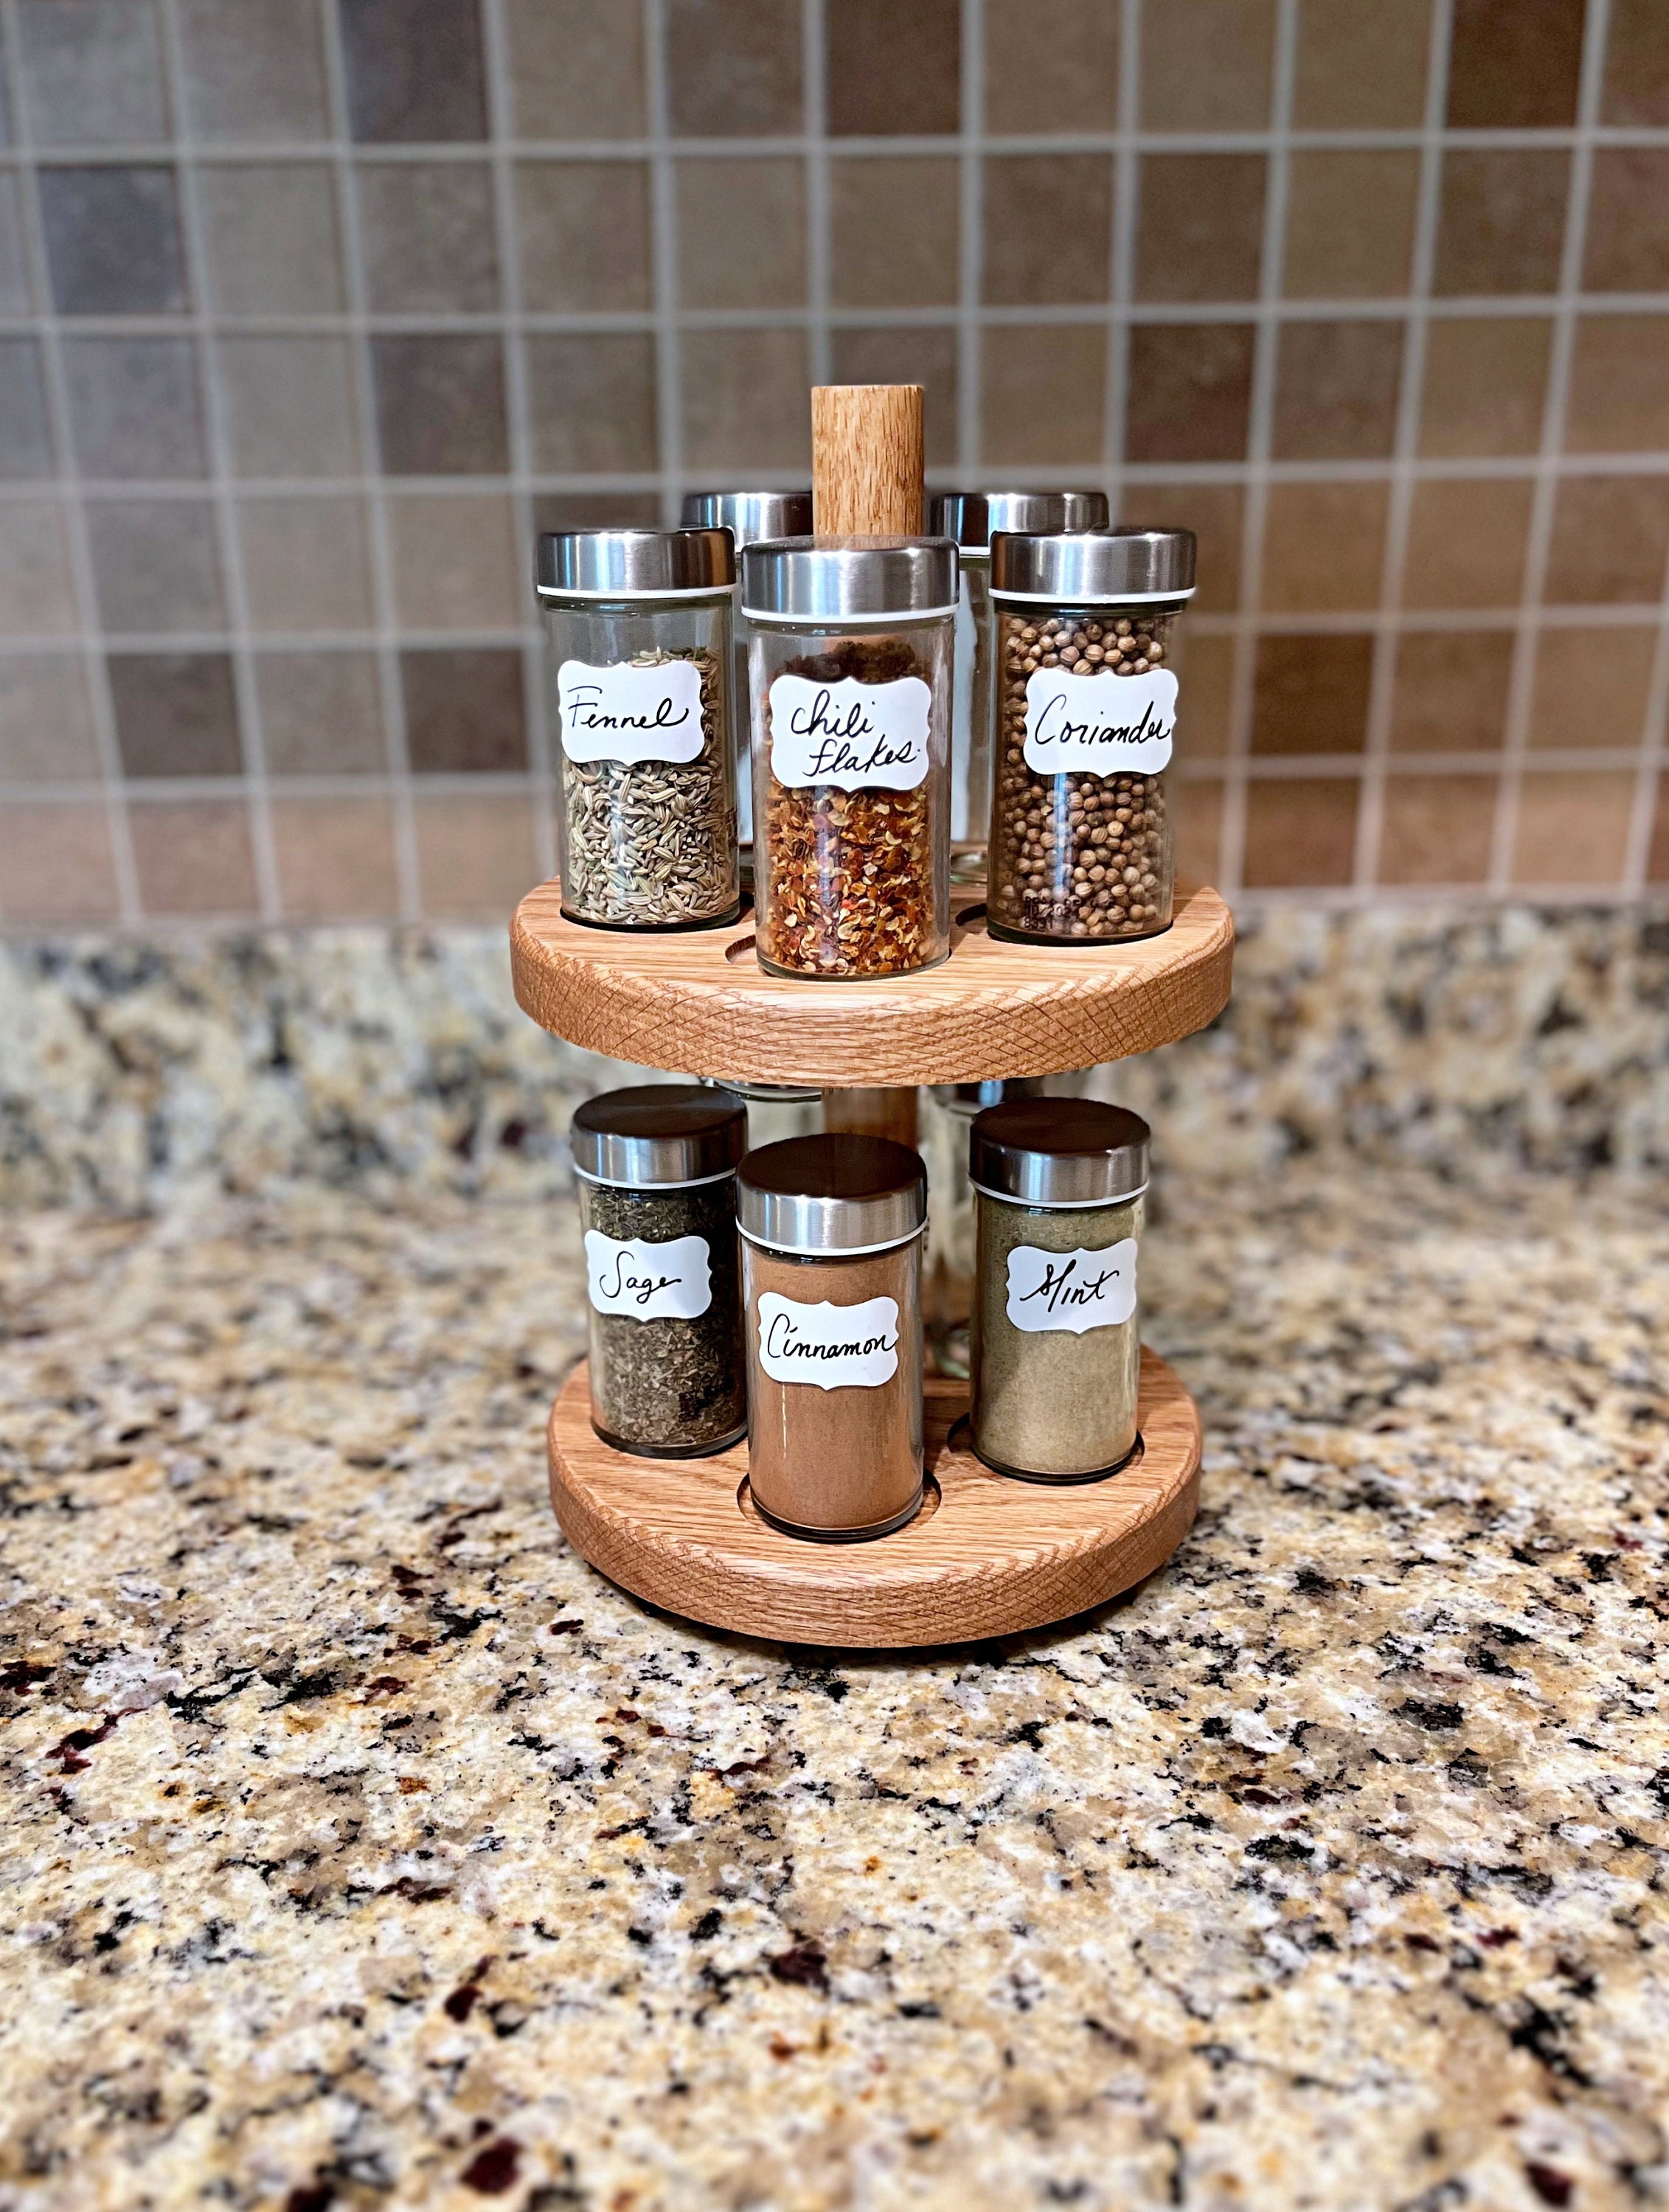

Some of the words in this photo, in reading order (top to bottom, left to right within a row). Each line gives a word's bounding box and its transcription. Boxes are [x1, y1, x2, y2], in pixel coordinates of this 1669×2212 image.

[567, 685, 690, 729] Fennel
[1034, 693, 1171, 745] Coriander
[599, 1251, 682, 1304] Sage
[1019, 1259, 1120, 1312] Mint
[767, 1313, 898, 1360] Cinnamon
